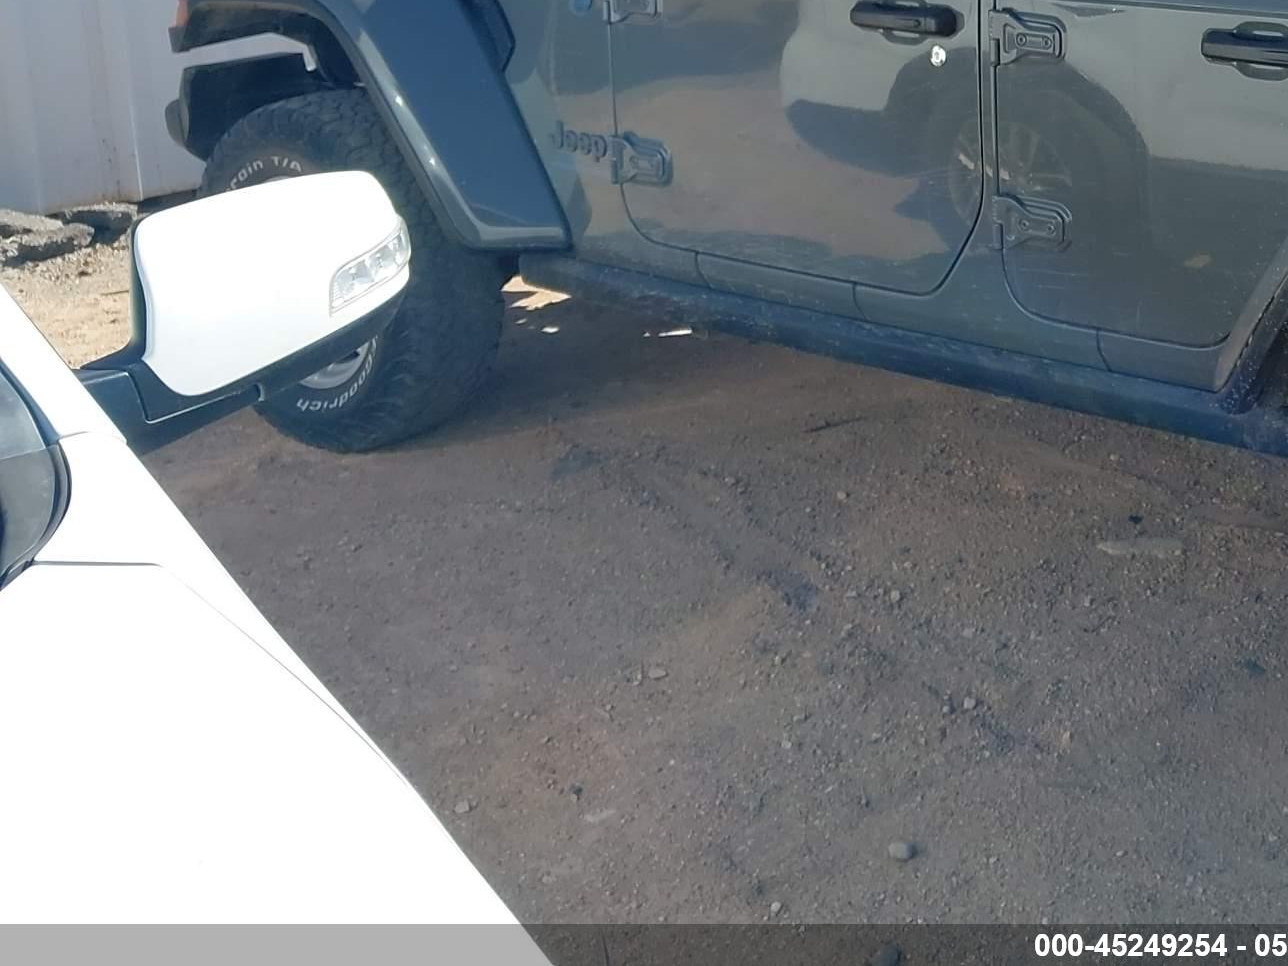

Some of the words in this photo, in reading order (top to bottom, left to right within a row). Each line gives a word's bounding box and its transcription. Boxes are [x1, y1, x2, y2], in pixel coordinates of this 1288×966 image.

[551, 119, 608, 163] Jeep
[223, 160, 264, 191] rain
[271, 155, 302, 173] T/A
